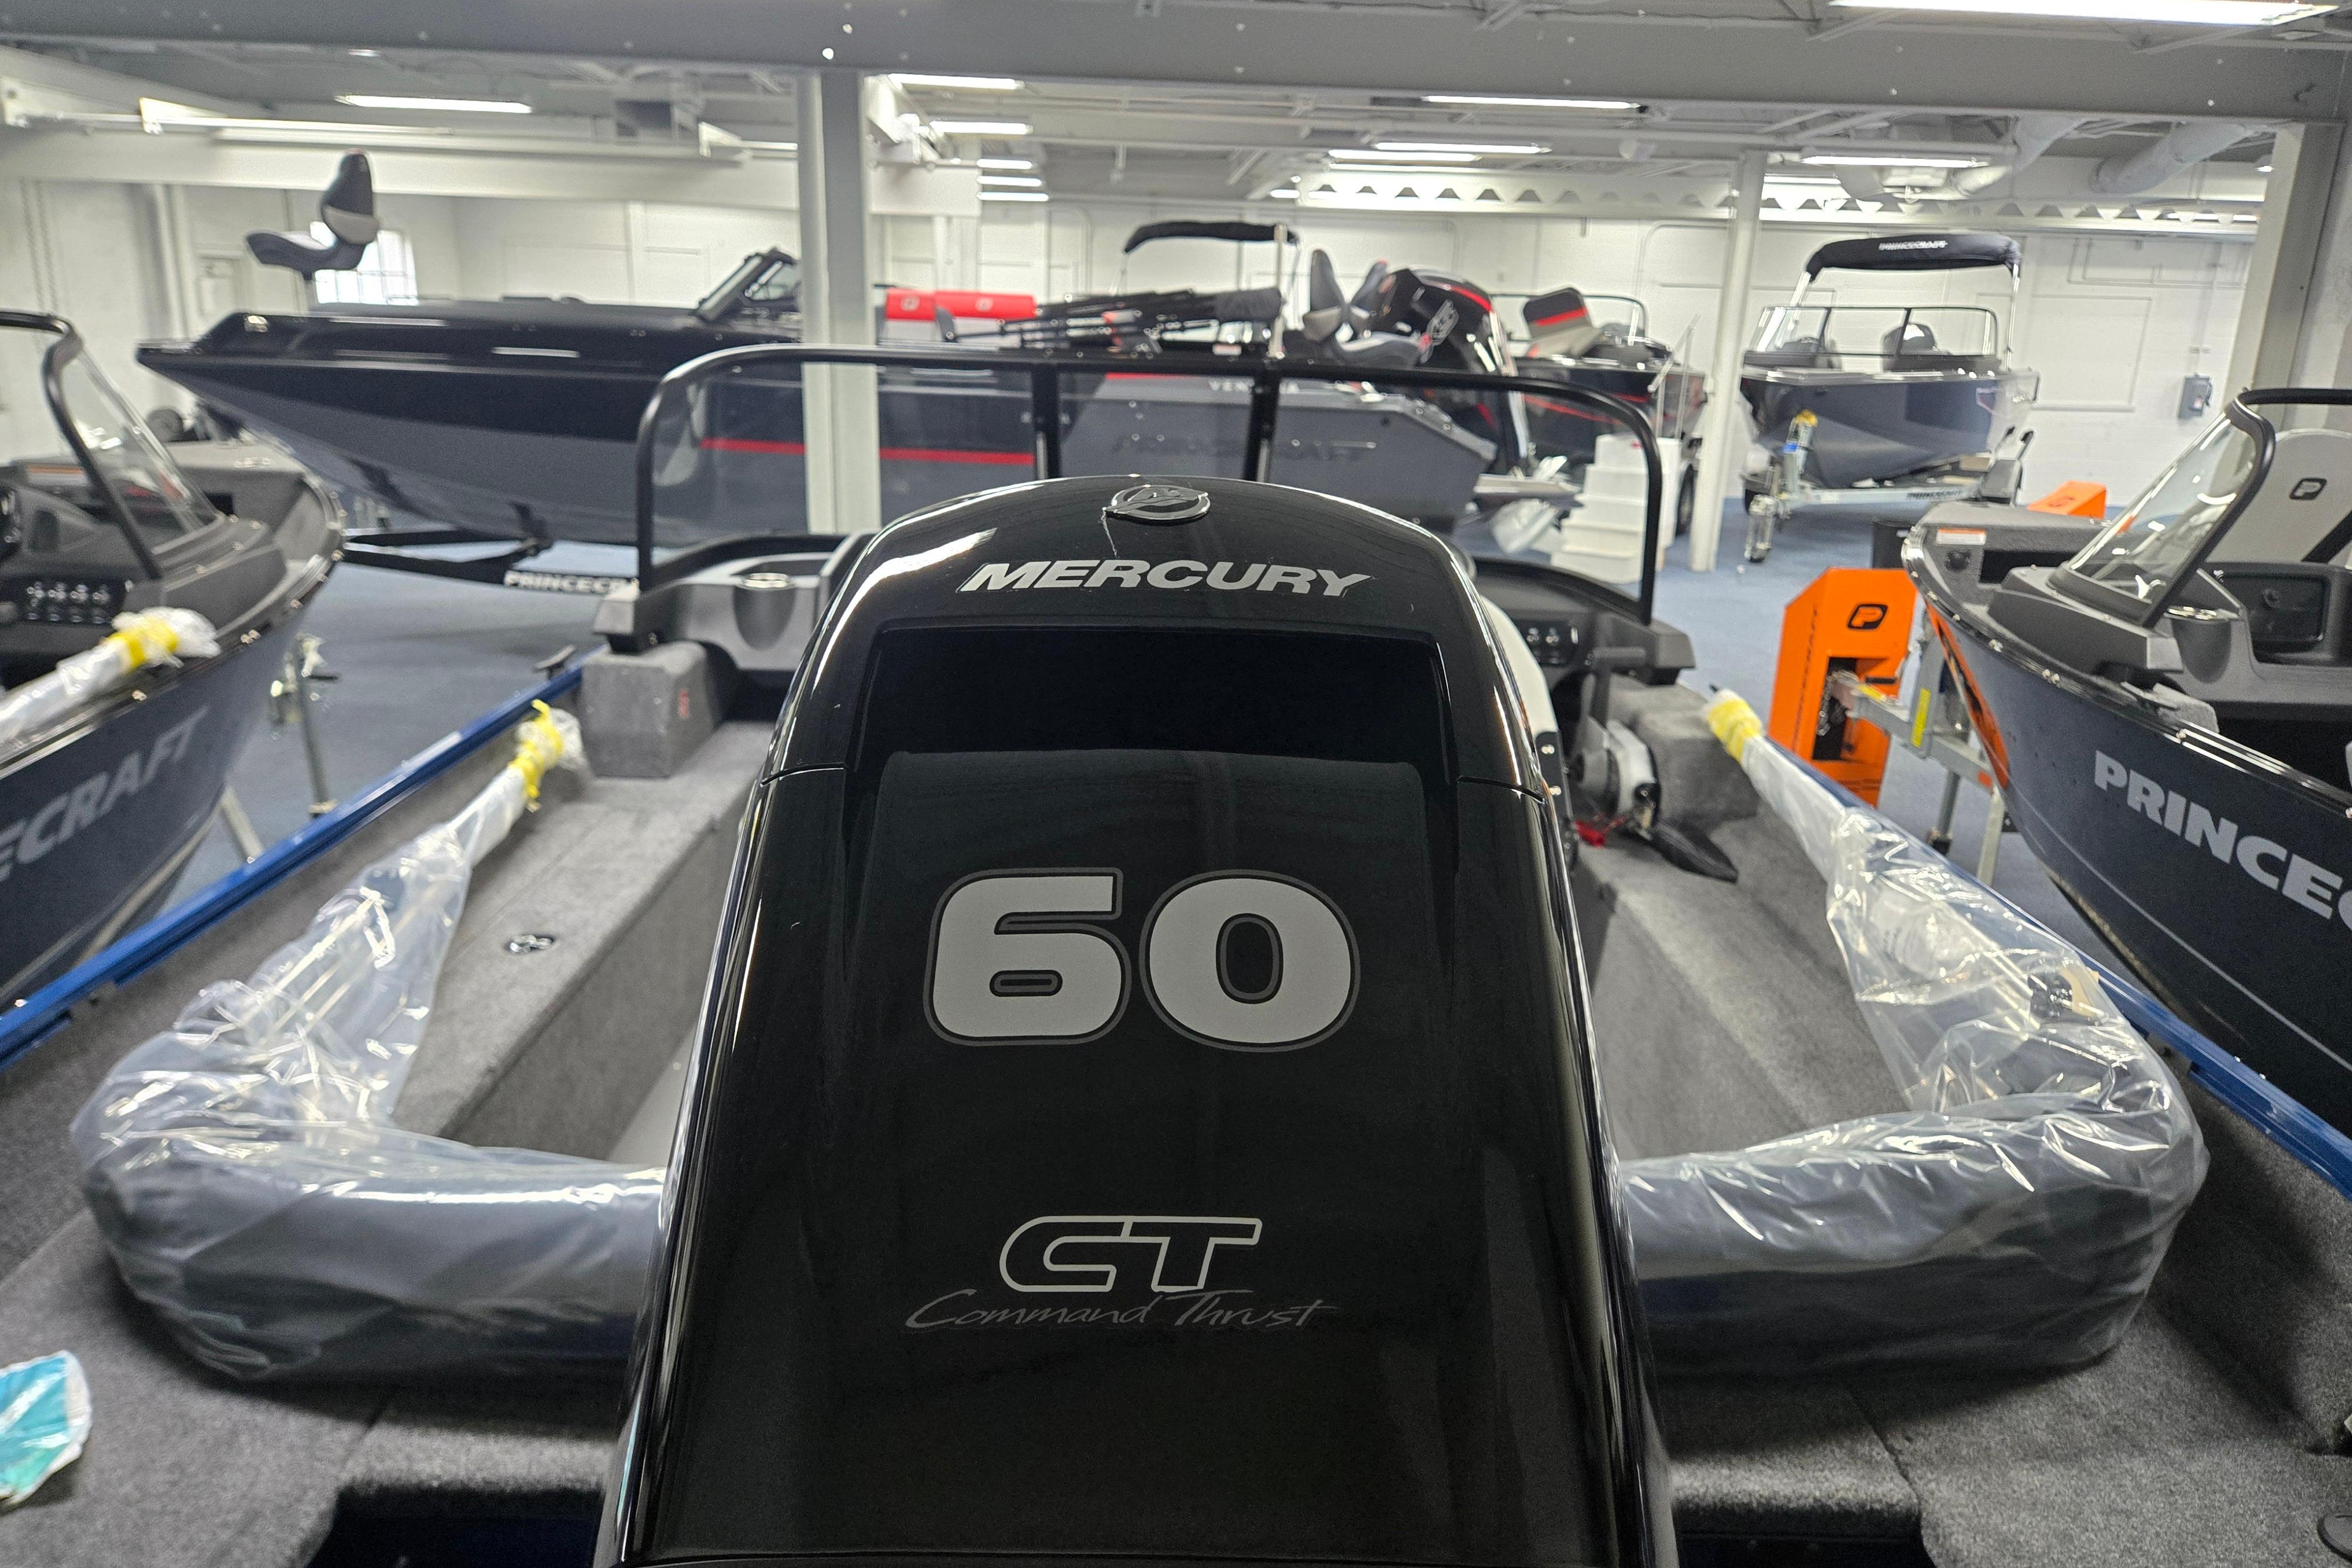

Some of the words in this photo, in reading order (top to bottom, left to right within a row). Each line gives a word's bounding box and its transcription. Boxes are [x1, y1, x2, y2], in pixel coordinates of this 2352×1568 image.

[957, 559, 1374, 597] MERCURY
[2094, 750, 2352, 932] PRINCE
[923, 868, 1360, 1051] 60
[904, 1289, 1164, 1330] Command
[1161, 1289, 1339, 1328] Thrust
